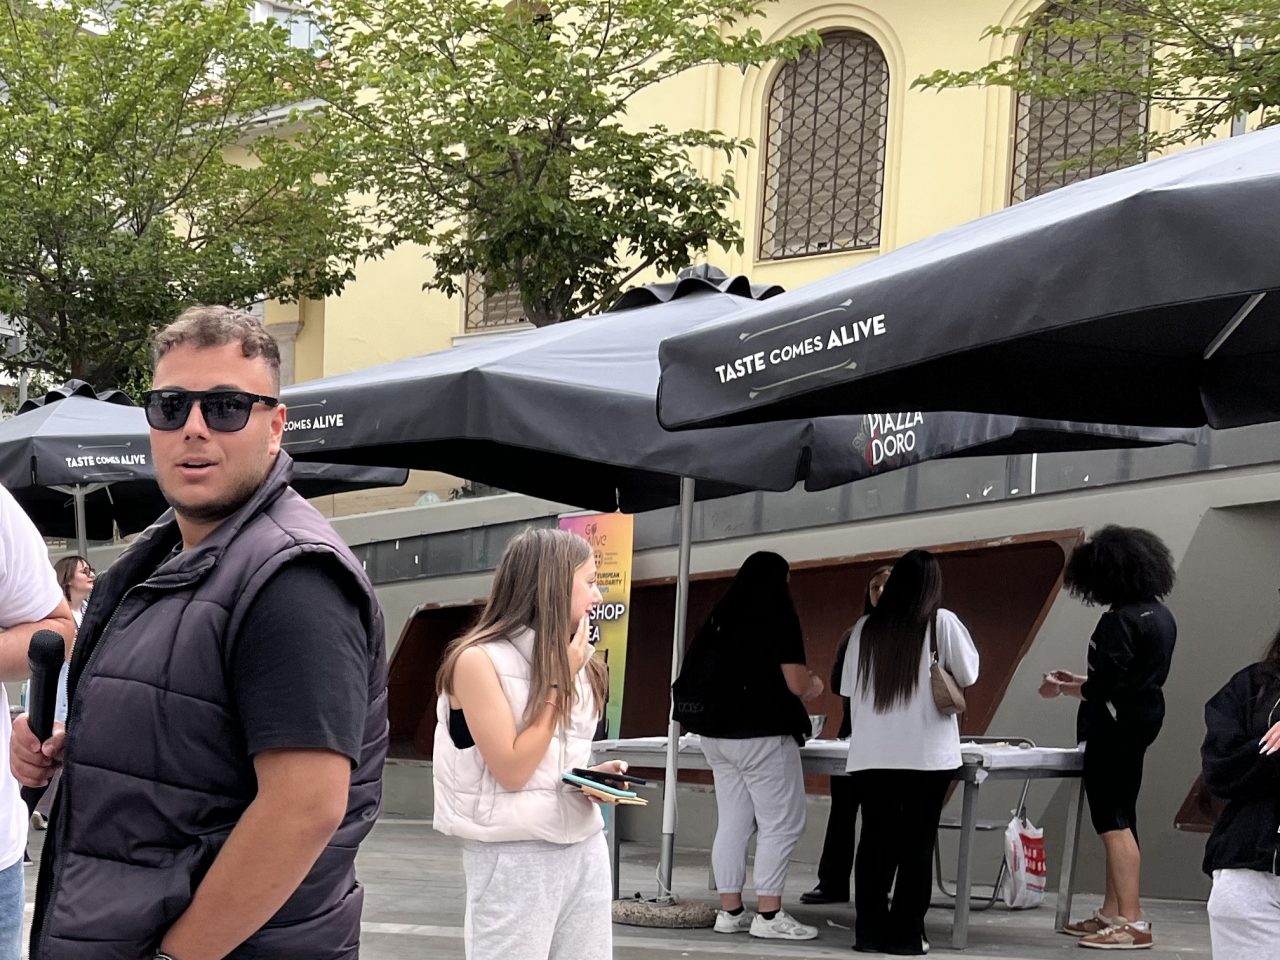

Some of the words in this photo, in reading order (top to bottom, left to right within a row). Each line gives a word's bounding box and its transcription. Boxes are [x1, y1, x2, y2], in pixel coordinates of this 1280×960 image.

[715, 351, 766, 383] TASTE
[770, 335, 823, 365] COMES
[826, 314, 886, 350] ALIVE
[283, 418, 312, 431] COMES
[313, 413, 344, 429] ALIVE
[868, 411, 924, 438] PIAZZA
[66, 456, 95, 468] TASTE
[96, 456, 120, 465] COMES
[121, 454, 146, 465] ALIVE
